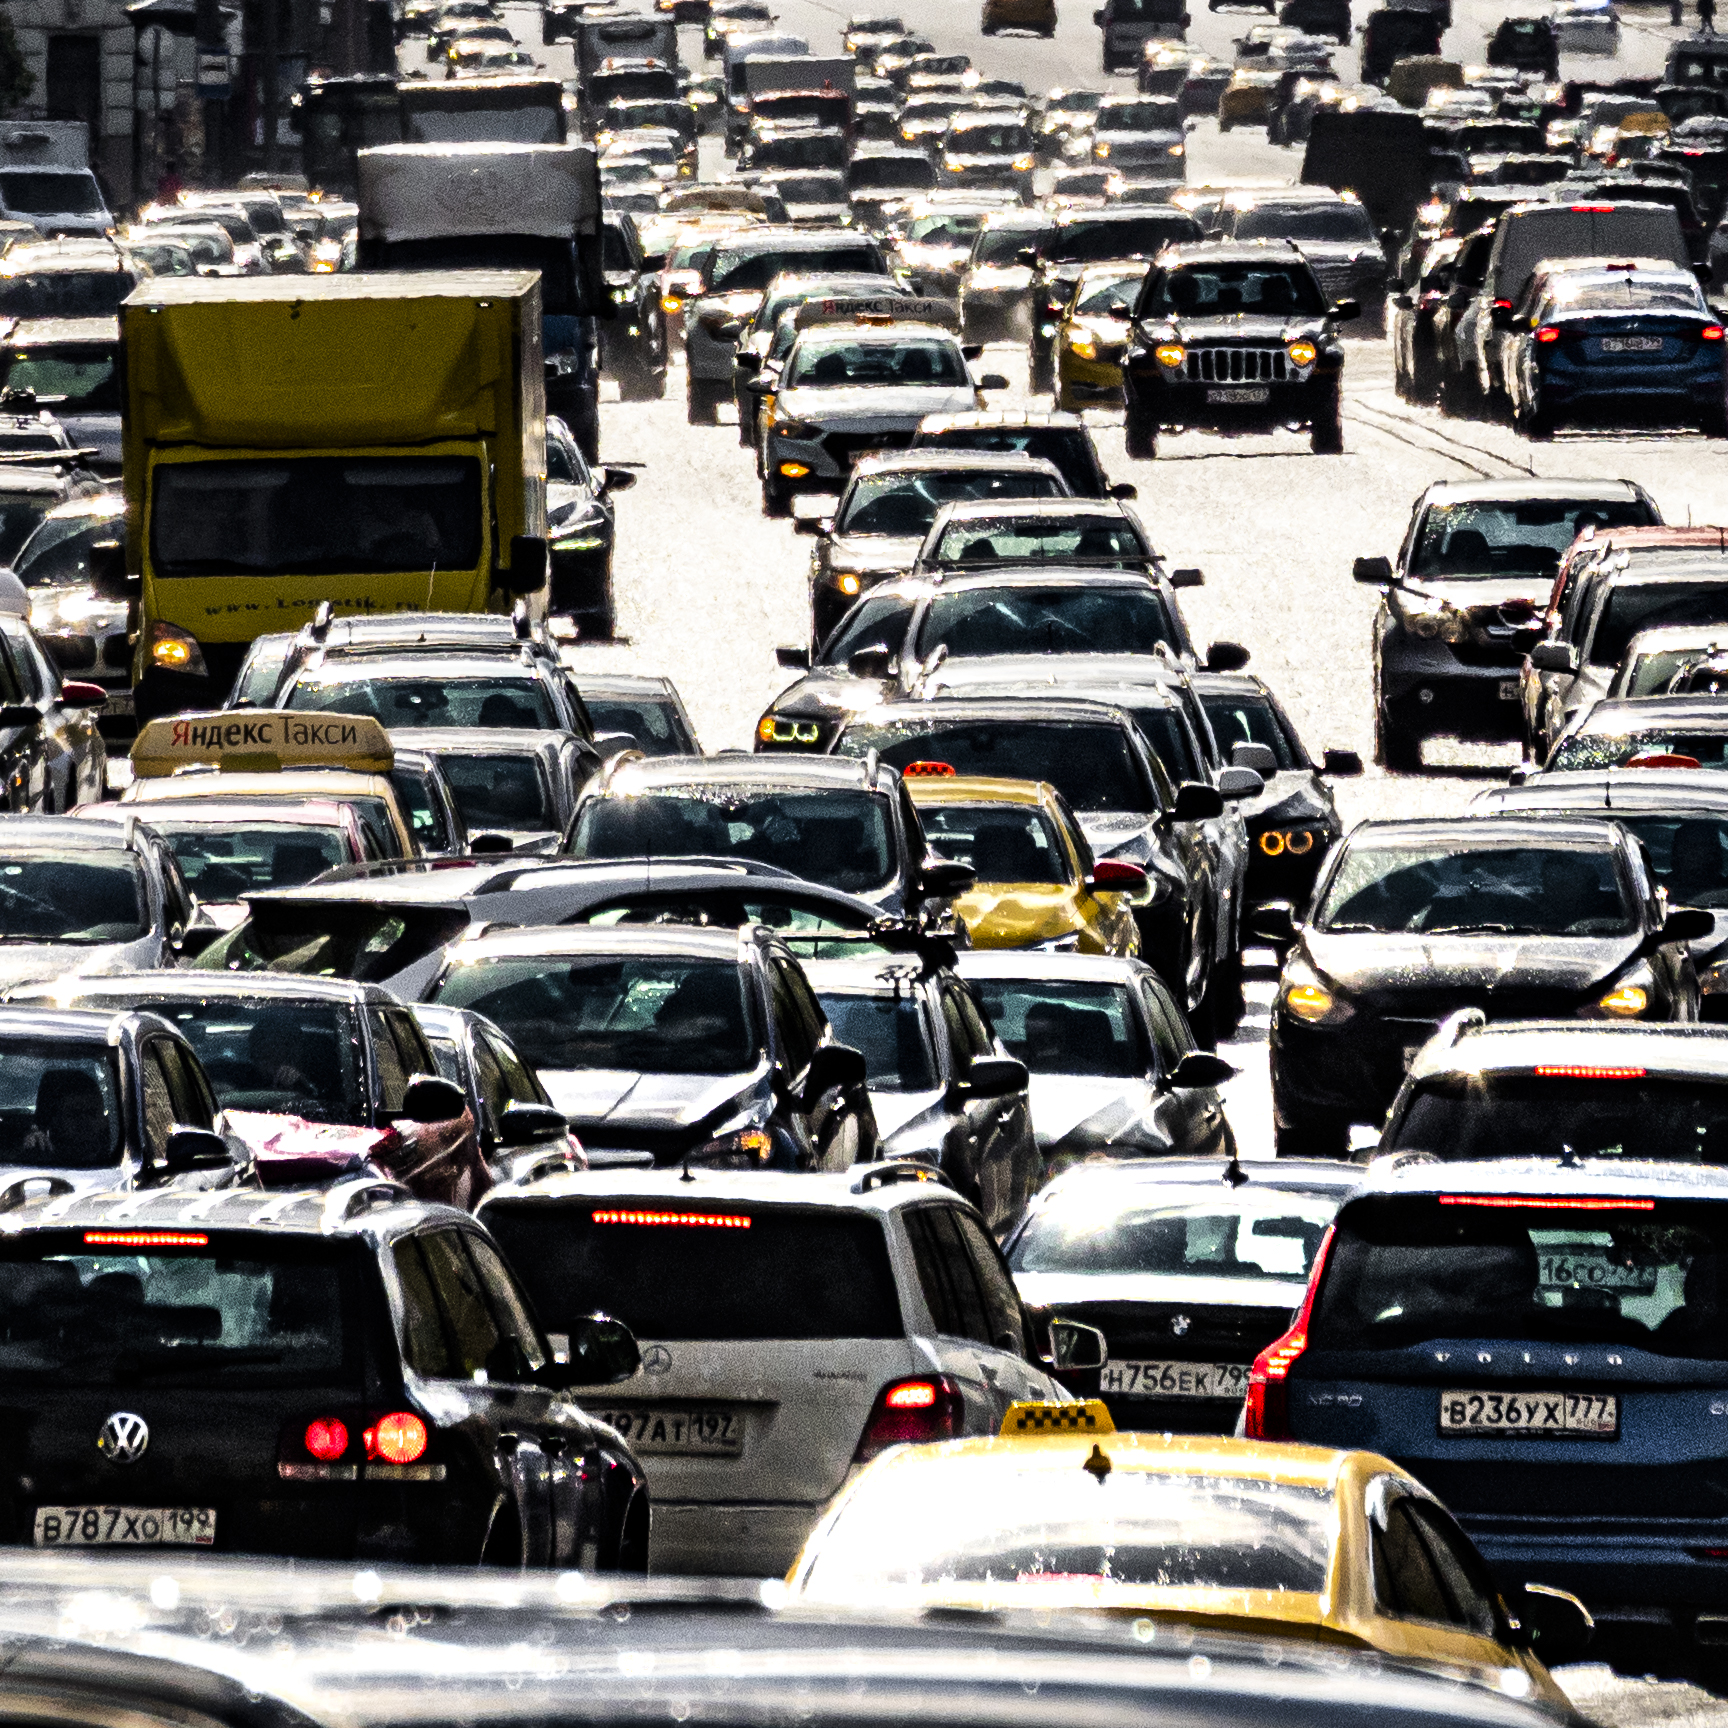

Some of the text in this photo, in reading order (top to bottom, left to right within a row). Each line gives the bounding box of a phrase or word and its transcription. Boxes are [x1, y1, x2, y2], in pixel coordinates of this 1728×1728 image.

[885, 301, 932, 314] Такси
[171, 717, 357, 750] Яндекс Такси
[1108, 1363, 1210, 1393] Н756ЕК
[1450, 1396, 1608, 1425] В236УХ 777
[44, 1510, 210, 1543] В787ХО 199
